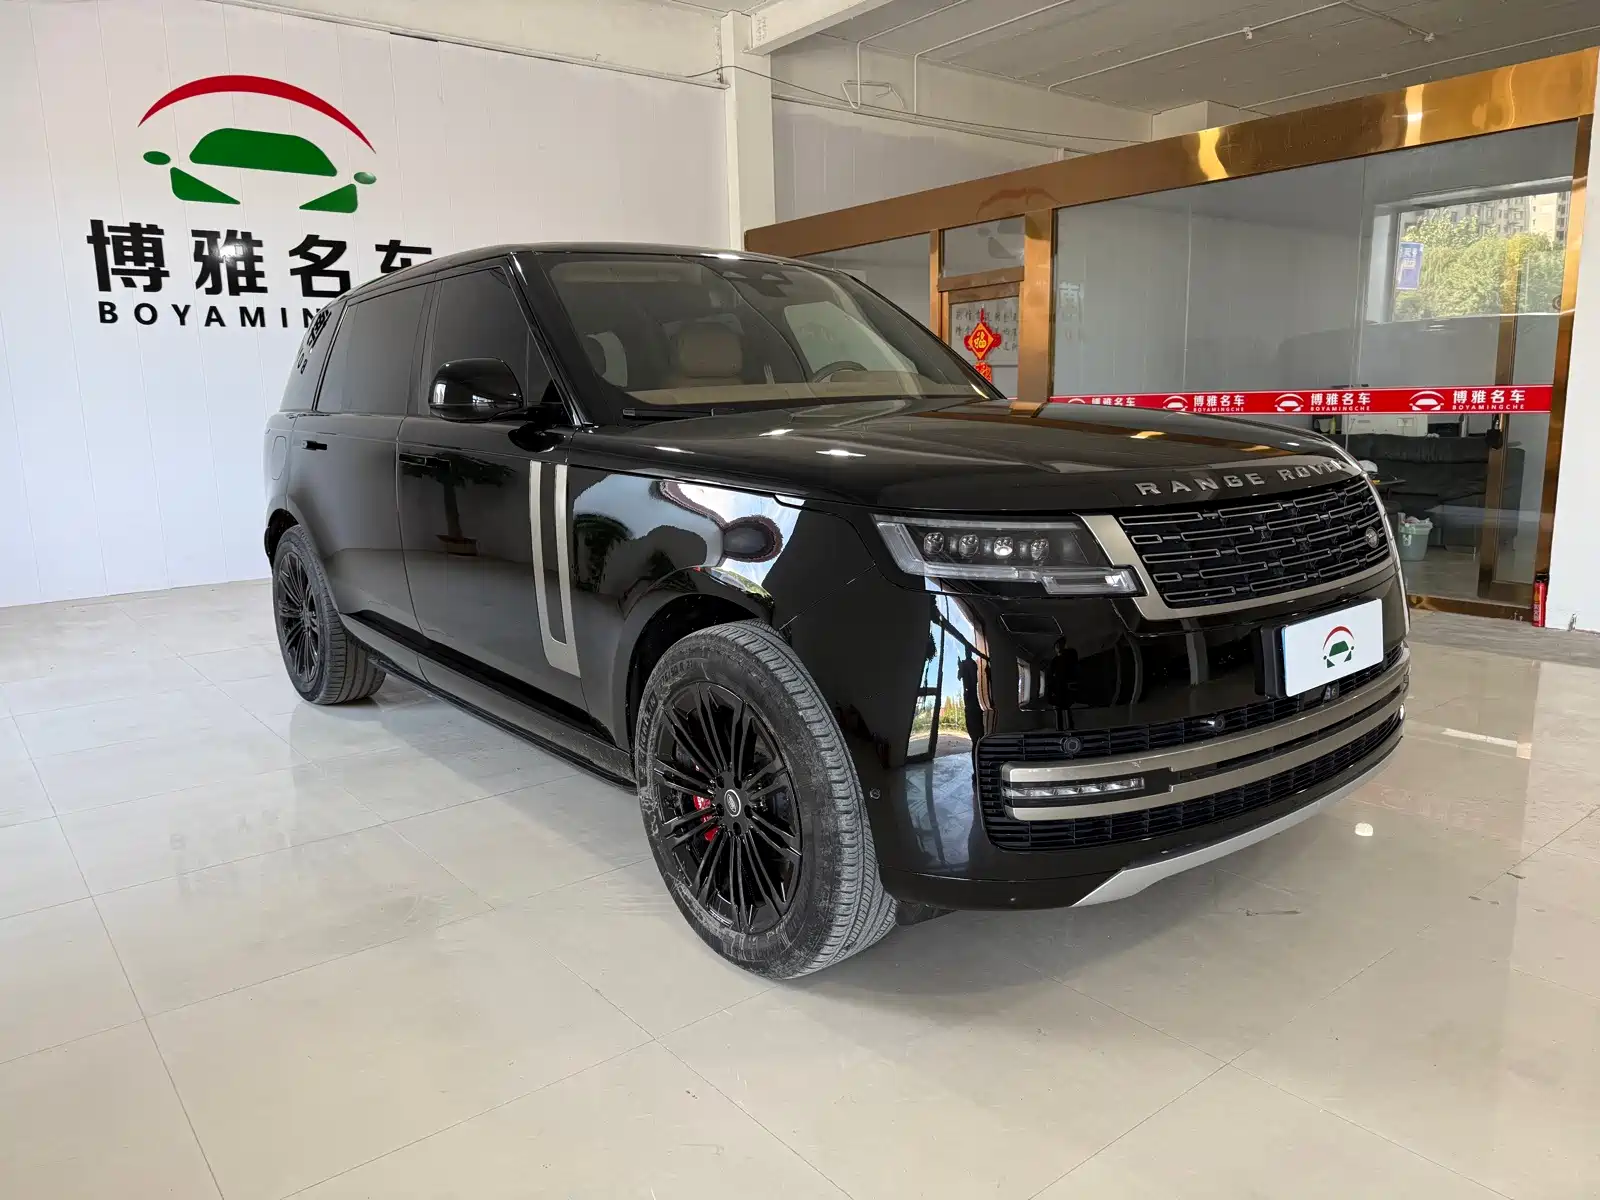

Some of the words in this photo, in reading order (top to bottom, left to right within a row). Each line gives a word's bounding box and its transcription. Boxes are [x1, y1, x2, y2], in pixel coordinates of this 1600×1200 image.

[974, 331, 987, 349] 福
[1194, 395, 1245, 407] 博雅名车
[1311, 393, 1371, 406] 博雅名车
[1453, 389, 1526, 404] 博雅名车
[1135, 472, 1265, 496] RANGE
